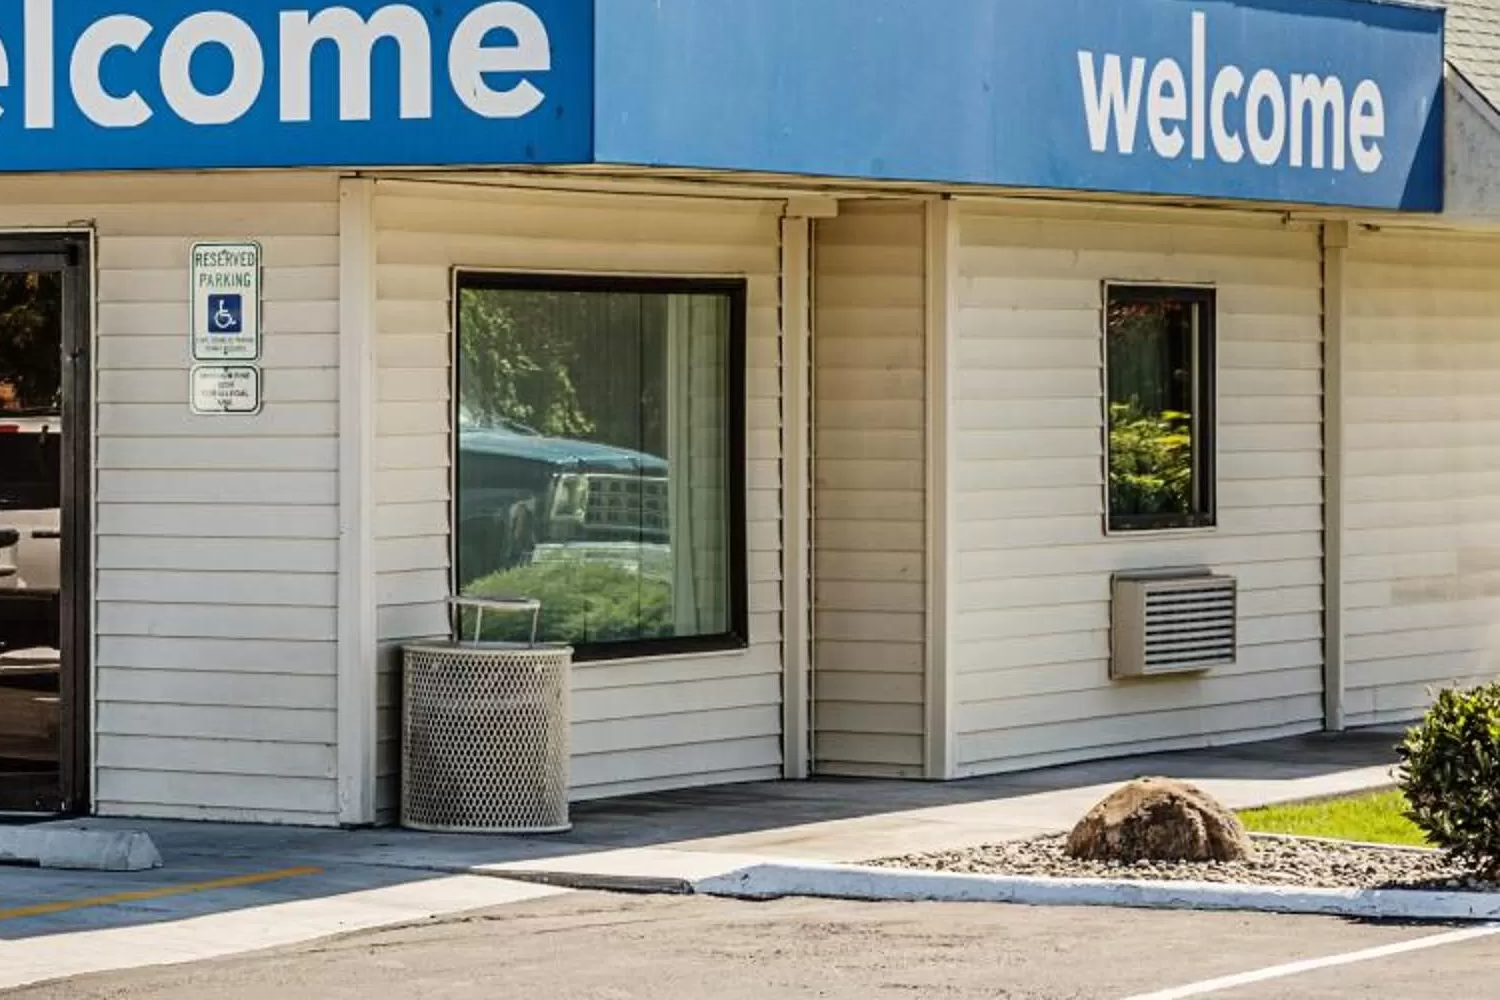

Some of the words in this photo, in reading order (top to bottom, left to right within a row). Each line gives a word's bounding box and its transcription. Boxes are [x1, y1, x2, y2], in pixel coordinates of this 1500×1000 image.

[1077, 10, 1386, 174] welcome
[195, 251, 256, 267] RESERVED
[199, 273, 251, 288] PARKING
